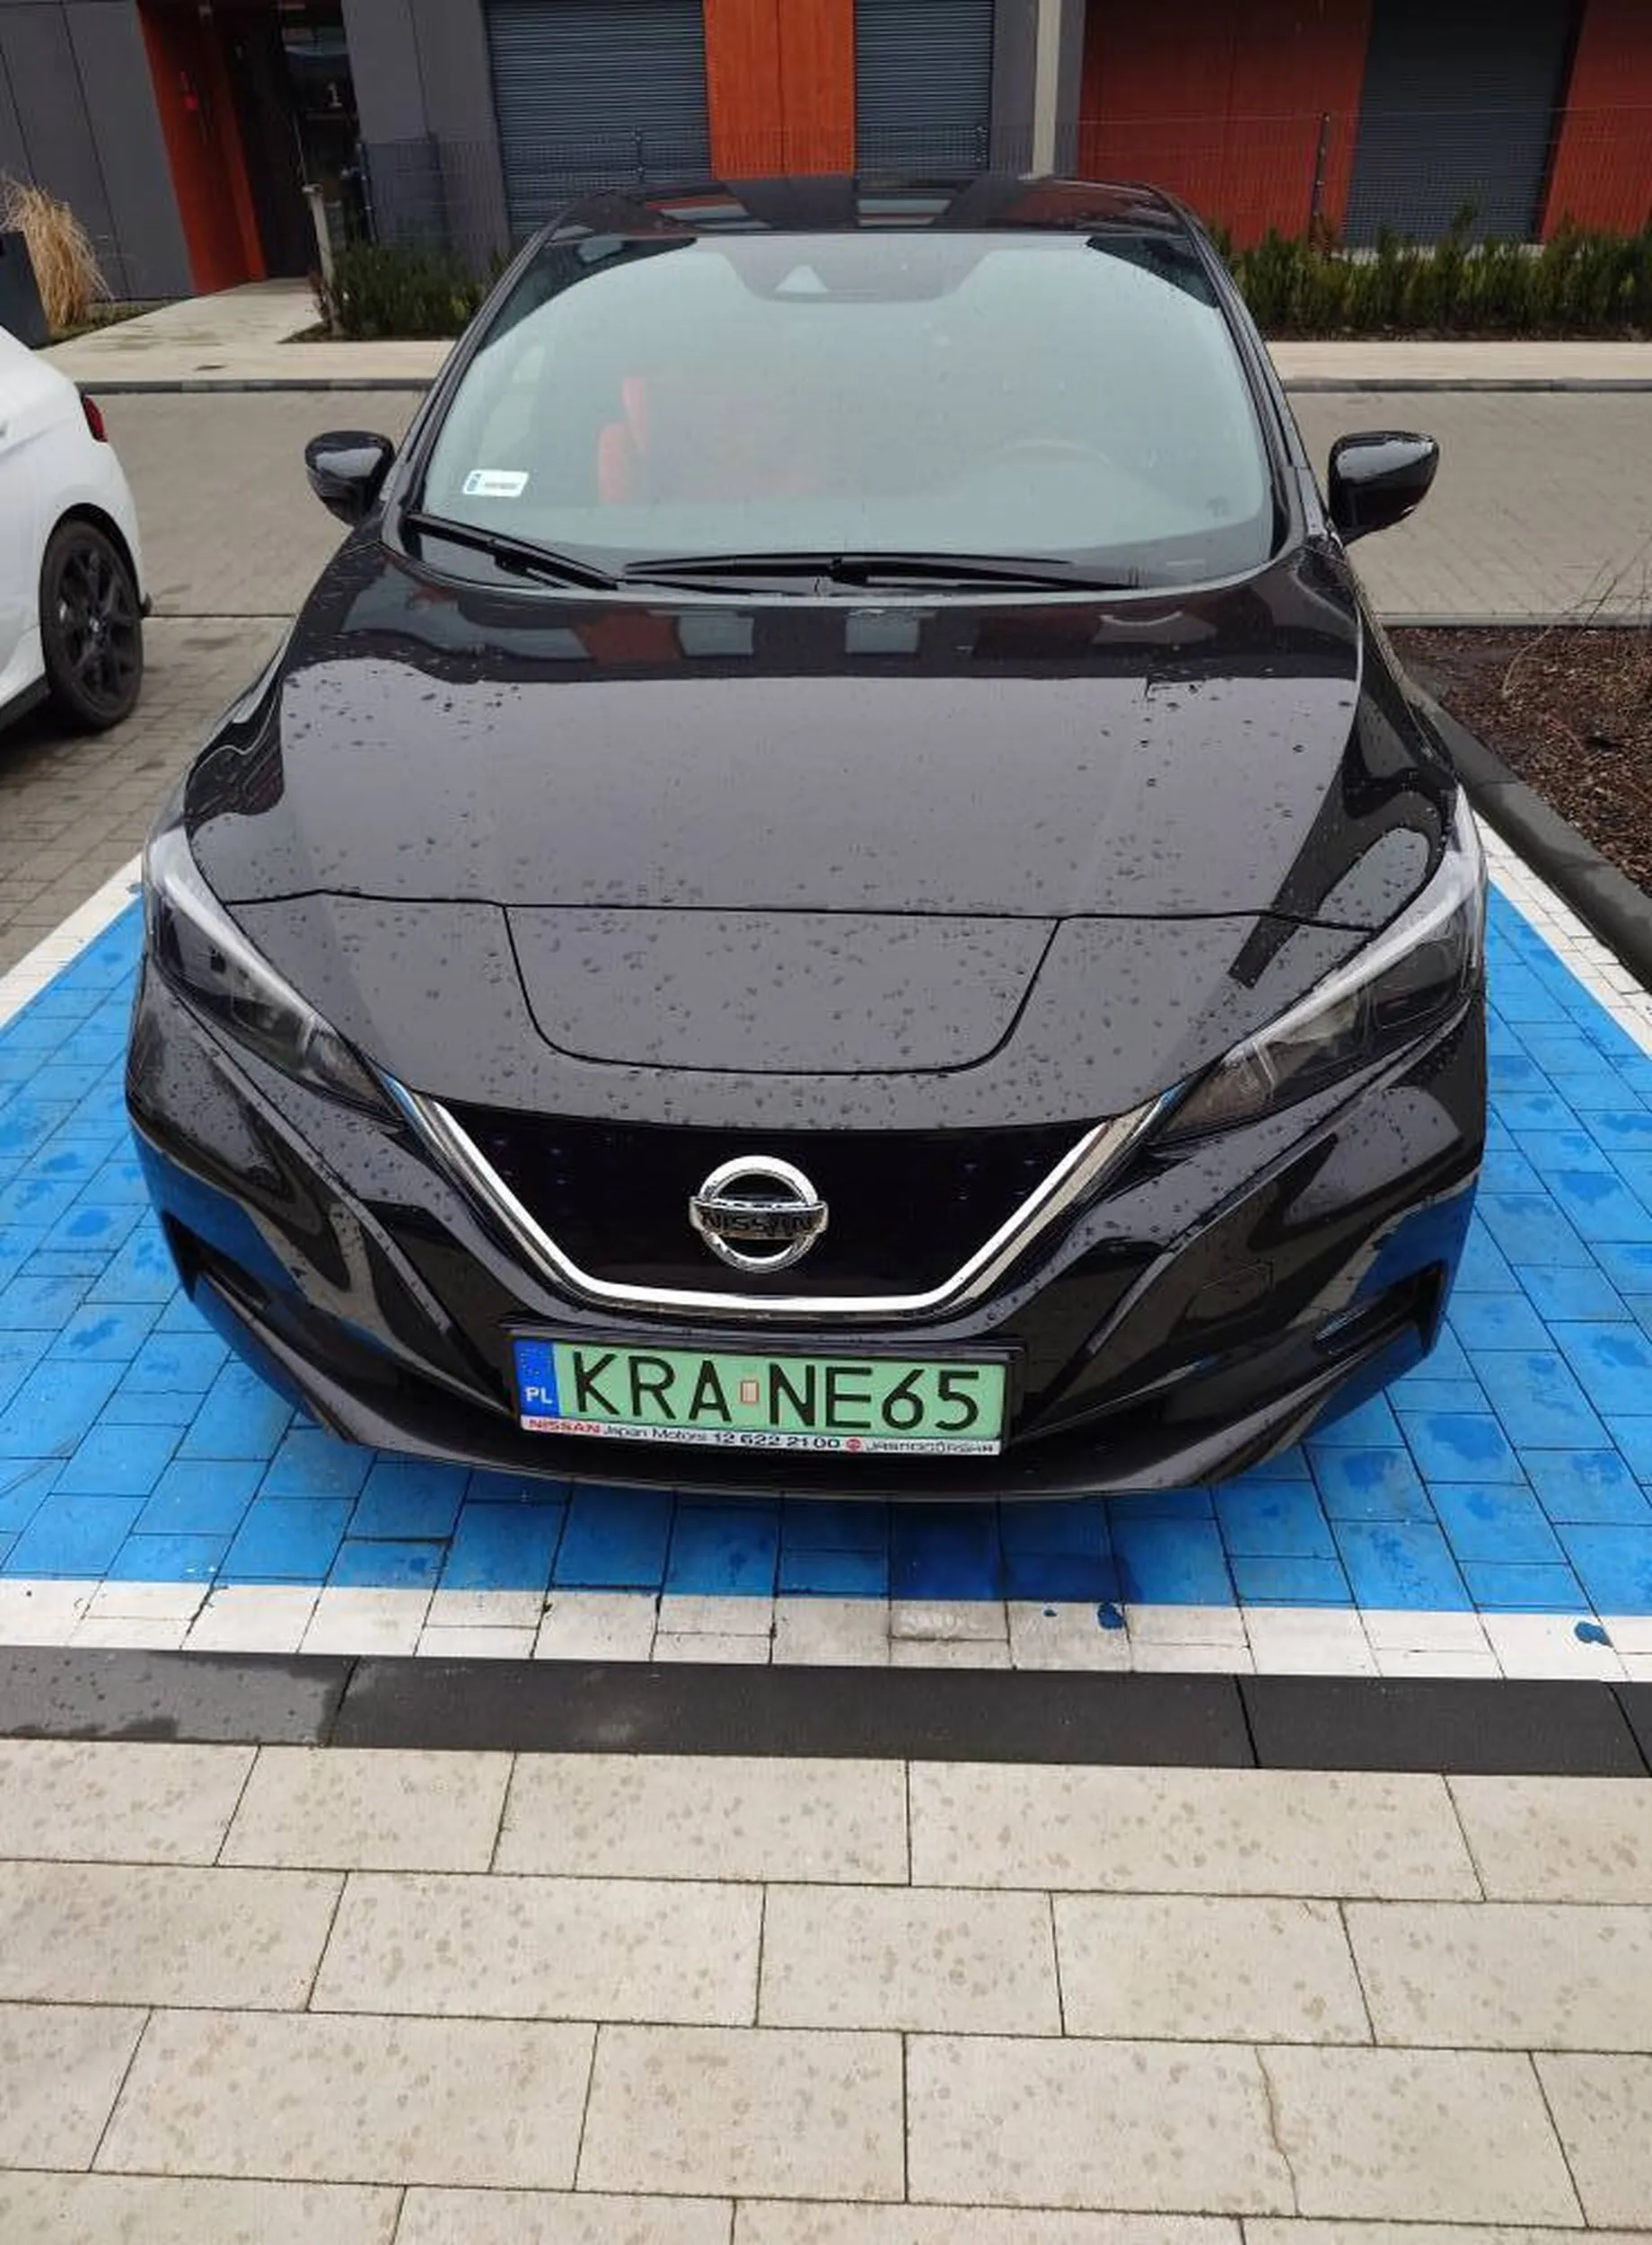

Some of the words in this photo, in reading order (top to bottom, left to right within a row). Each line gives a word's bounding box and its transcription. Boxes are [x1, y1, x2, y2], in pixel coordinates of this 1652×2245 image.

[700, 1211, 821, 1236] NISSAN
[525, 1387, 553, 1404] PL
[573, 1351, 732, 1422] KRA
[769, 1362, 980, 1431] NE65
[528, 1419, 602, 1434] NISSAN
[603, 1425, 648, 1439] Japan
[652, 1428, 707, 1442] Motors
[715, 1432, 735, 1444] 12
[786, 1436, 840, 1449] 2100
